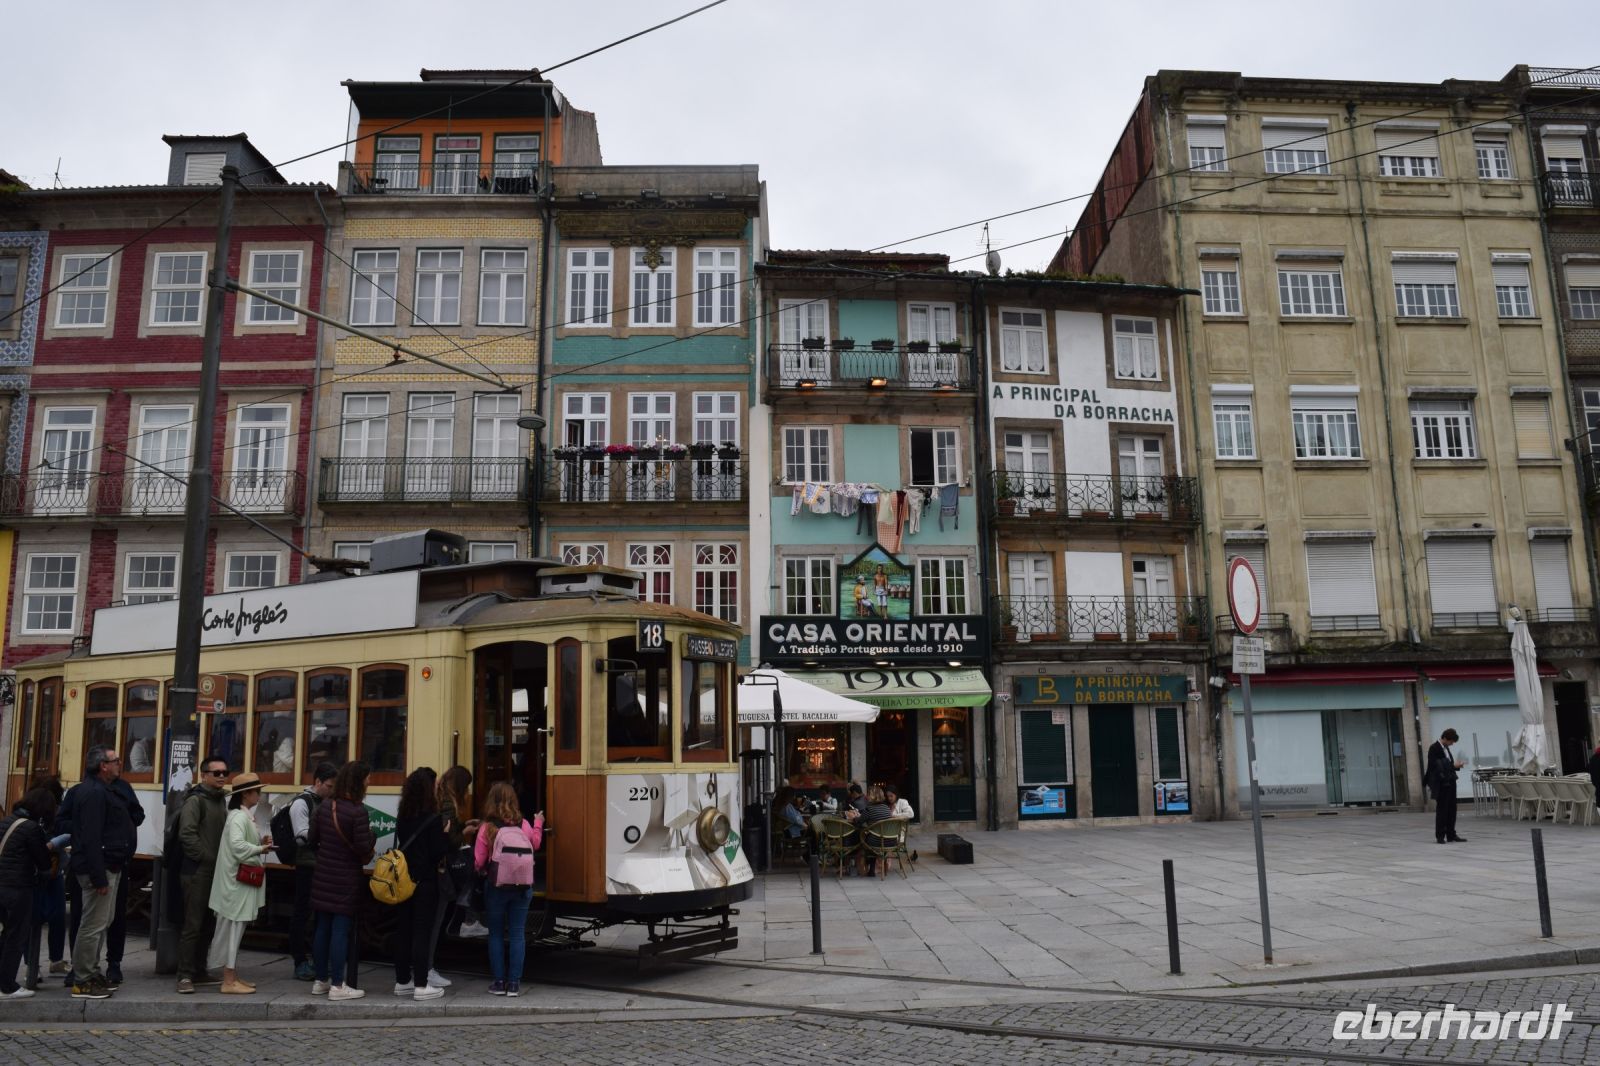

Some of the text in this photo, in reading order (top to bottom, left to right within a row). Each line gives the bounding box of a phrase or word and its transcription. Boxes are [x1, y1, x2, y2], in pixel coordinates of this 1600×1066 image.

[993, 385, 1100, 403] A PRINCIPAL
[1054, 404, 1174, 422] DA BORRACHA
[202, 607, 235, 632] Corte
[643, 623, 662, 648] 18
[768, 622, 977, 643] CASA ORIENTAL
[778, 643, 963, 656] A Tradição Portuguesa desde 1910
[842, 669, 943, 693] 1910
[1075, 676, 1160, 688] A PRINCIPAL
[906, 698, 920, 706] DO
[925, 697, 955, 705] PORTO
[1075, 690, 1173, 703] DA BORRACHA
[738, 713, 770, 722] TUGUESA
[802, 712, 839, 720] BACALHAU
[174, 744, 192, 752] CASAS
[629, 786, 659, 801] 220
